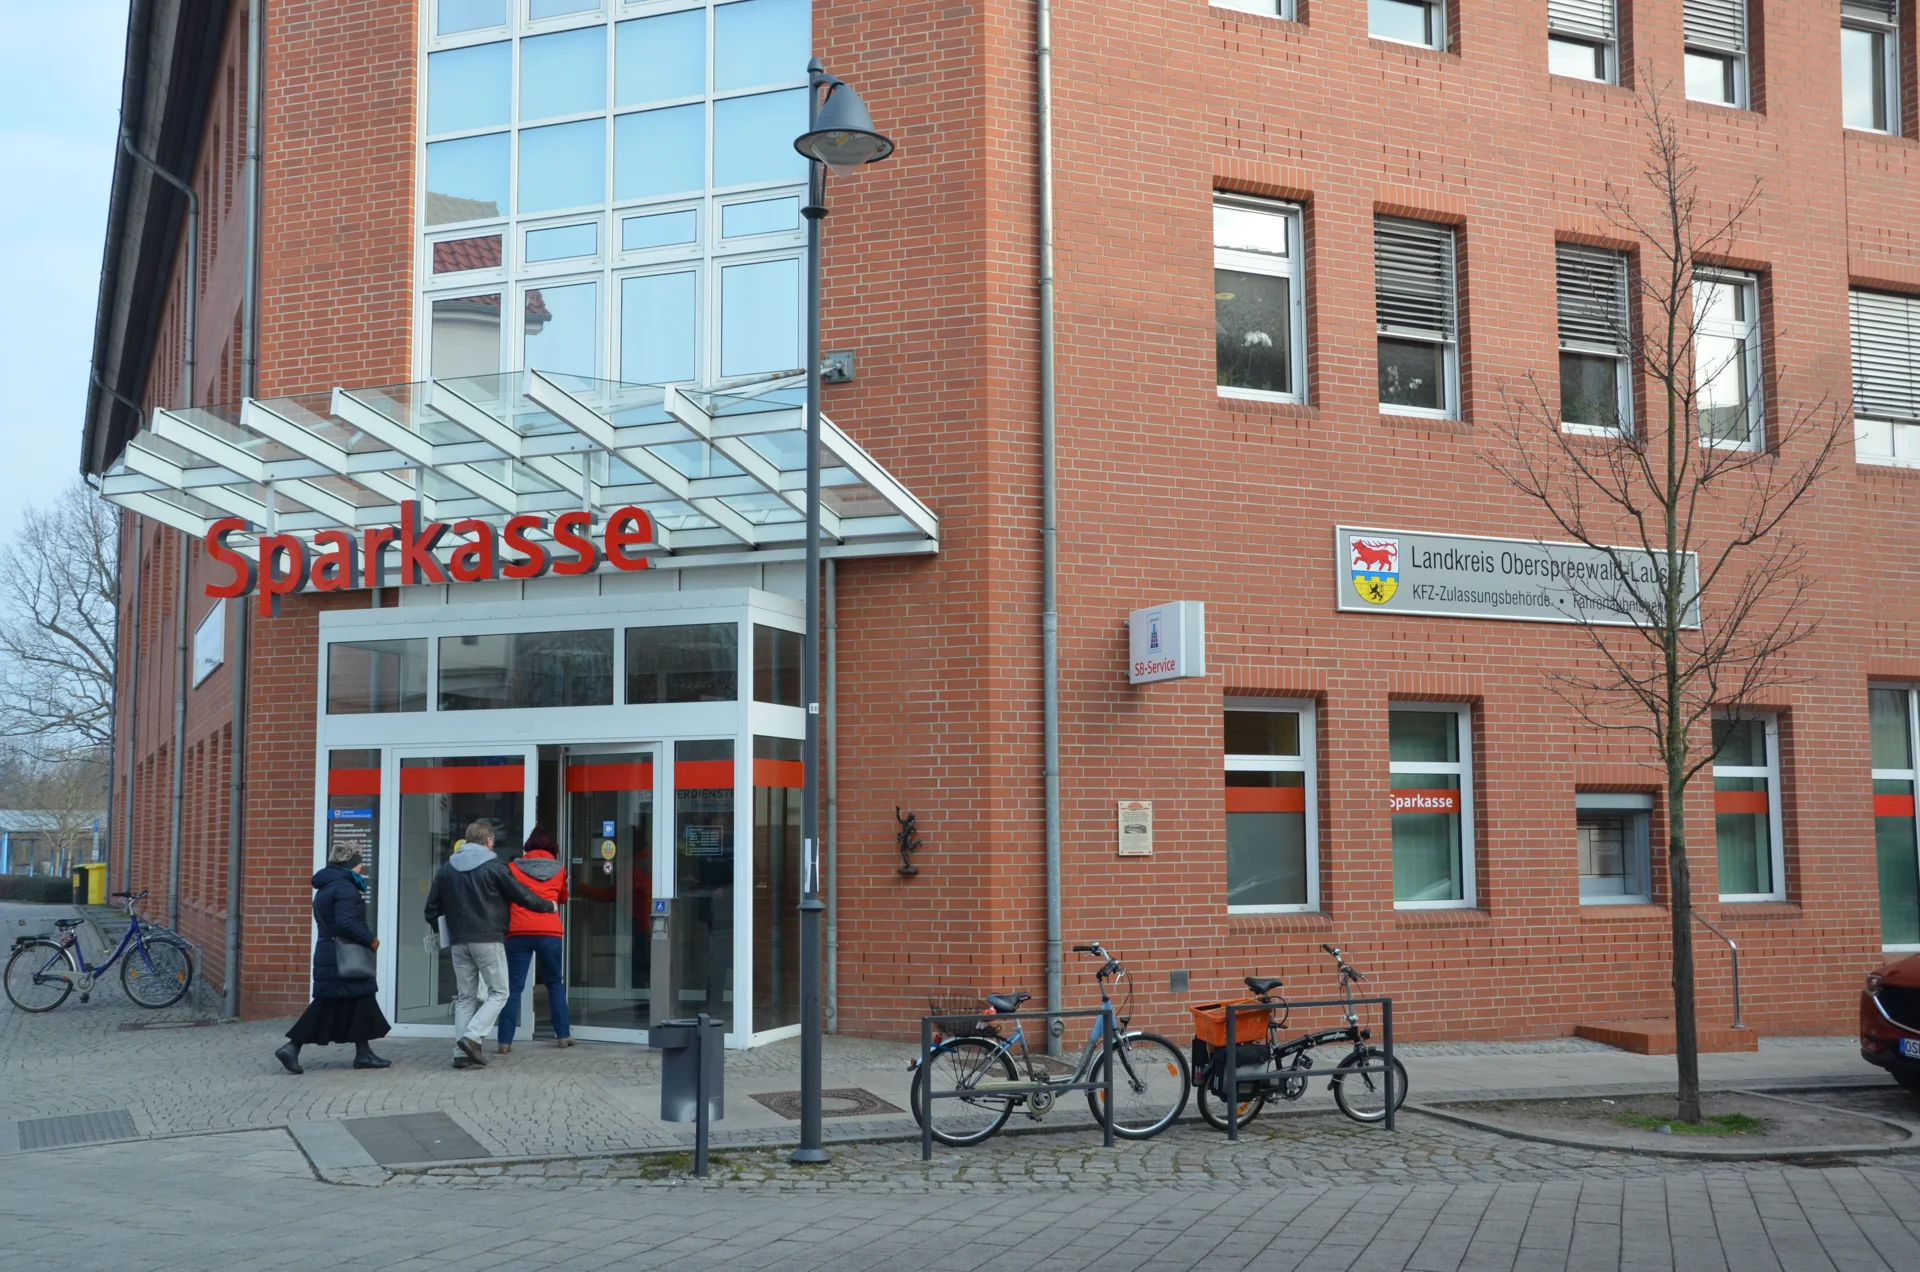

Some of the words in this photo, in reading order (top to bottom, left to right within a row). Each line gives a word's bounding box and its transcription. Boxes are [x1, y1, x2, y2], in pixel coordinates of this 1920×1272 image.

[204, 499, 657, 617] Sparkasse
[1411, 545, 1495, 573] Landkreis
[1501, 551, 1685, 586] Oberspreewald-Laus
[1412, 584, 1551, 608] KFZ-Zulassungsbehörde
[1134, 657, 1176, 677] SB-Service
[1389, 793, 1453, 811] Sparkasse
